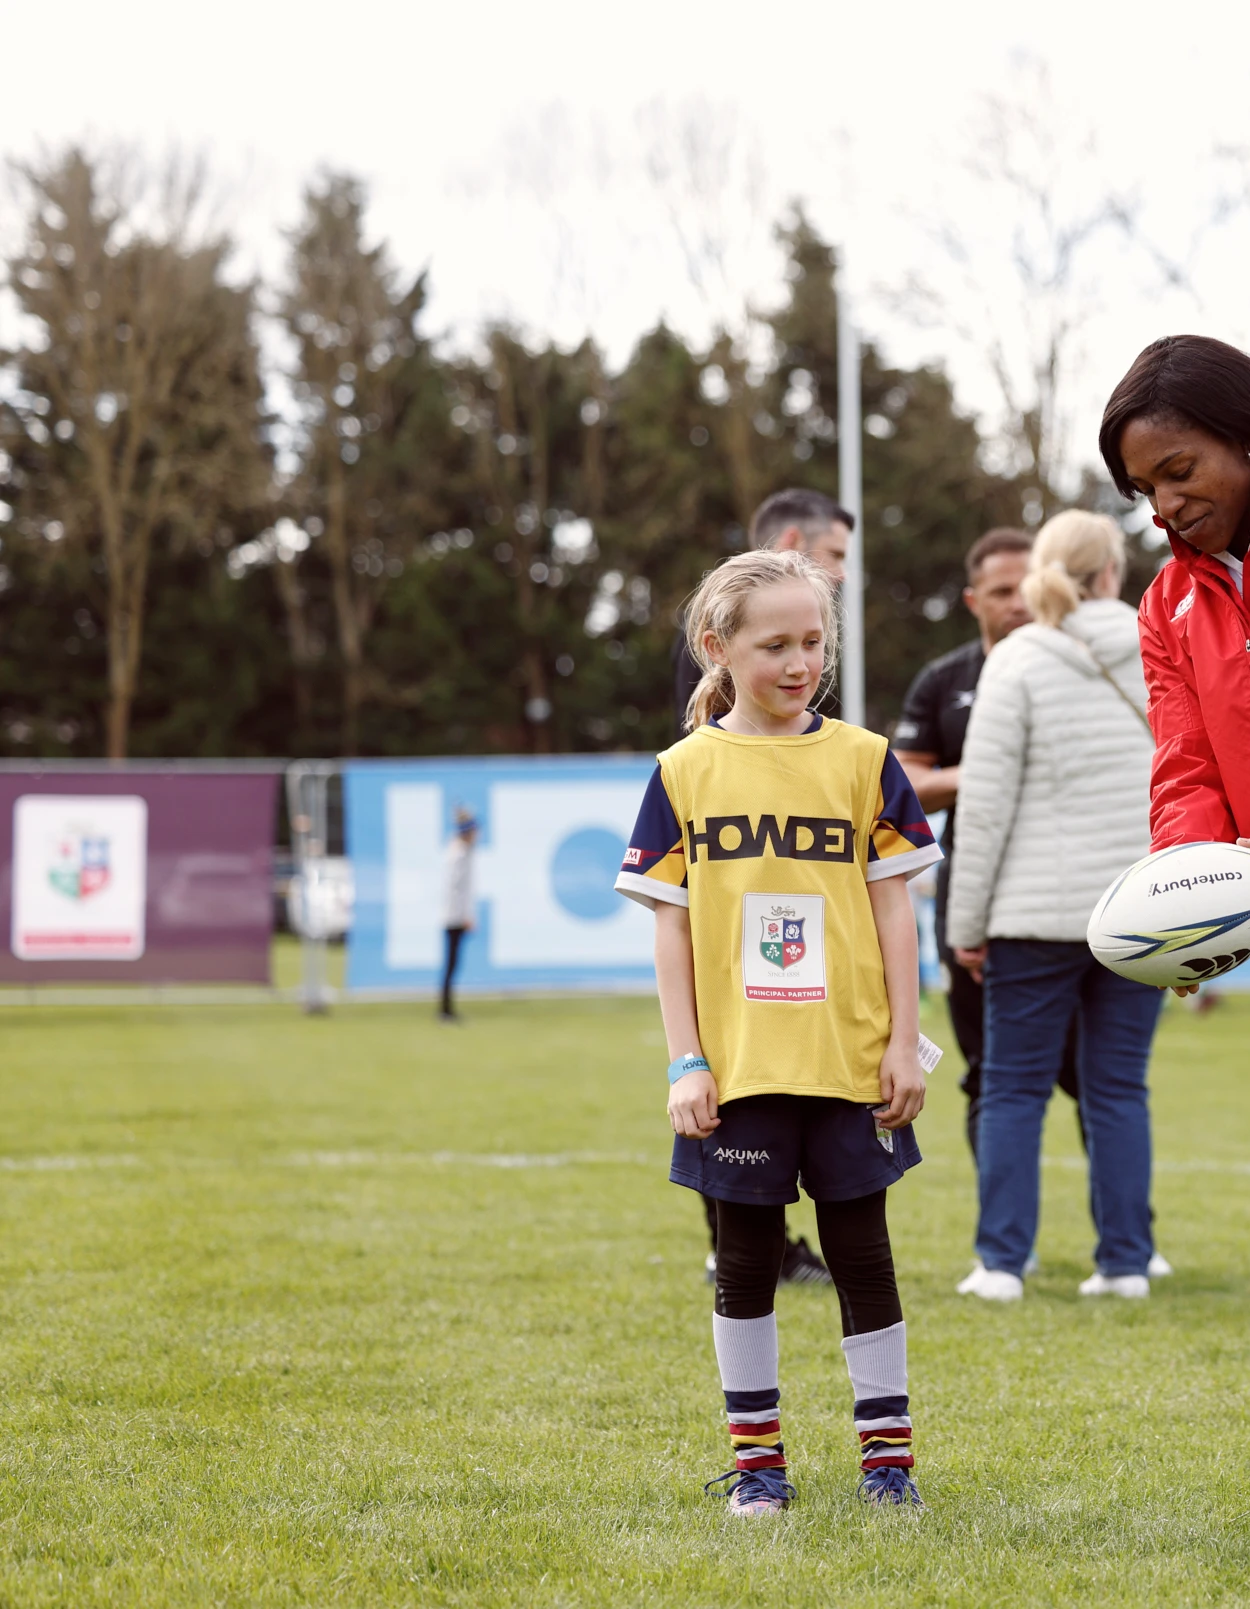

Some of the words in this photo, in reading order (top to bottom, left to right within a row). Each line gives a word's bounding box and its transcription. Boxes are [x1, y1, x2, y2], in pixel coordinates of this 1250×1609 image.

[687, 814, 856, 864] HOWDE
[1152, 871, 1243, 896] canterbury
[748, 989, 786, 997] PRINCIPAL
[788, 990, 822, 998] PARTNER
[713, 1146, 770, 1160] AKUMA
